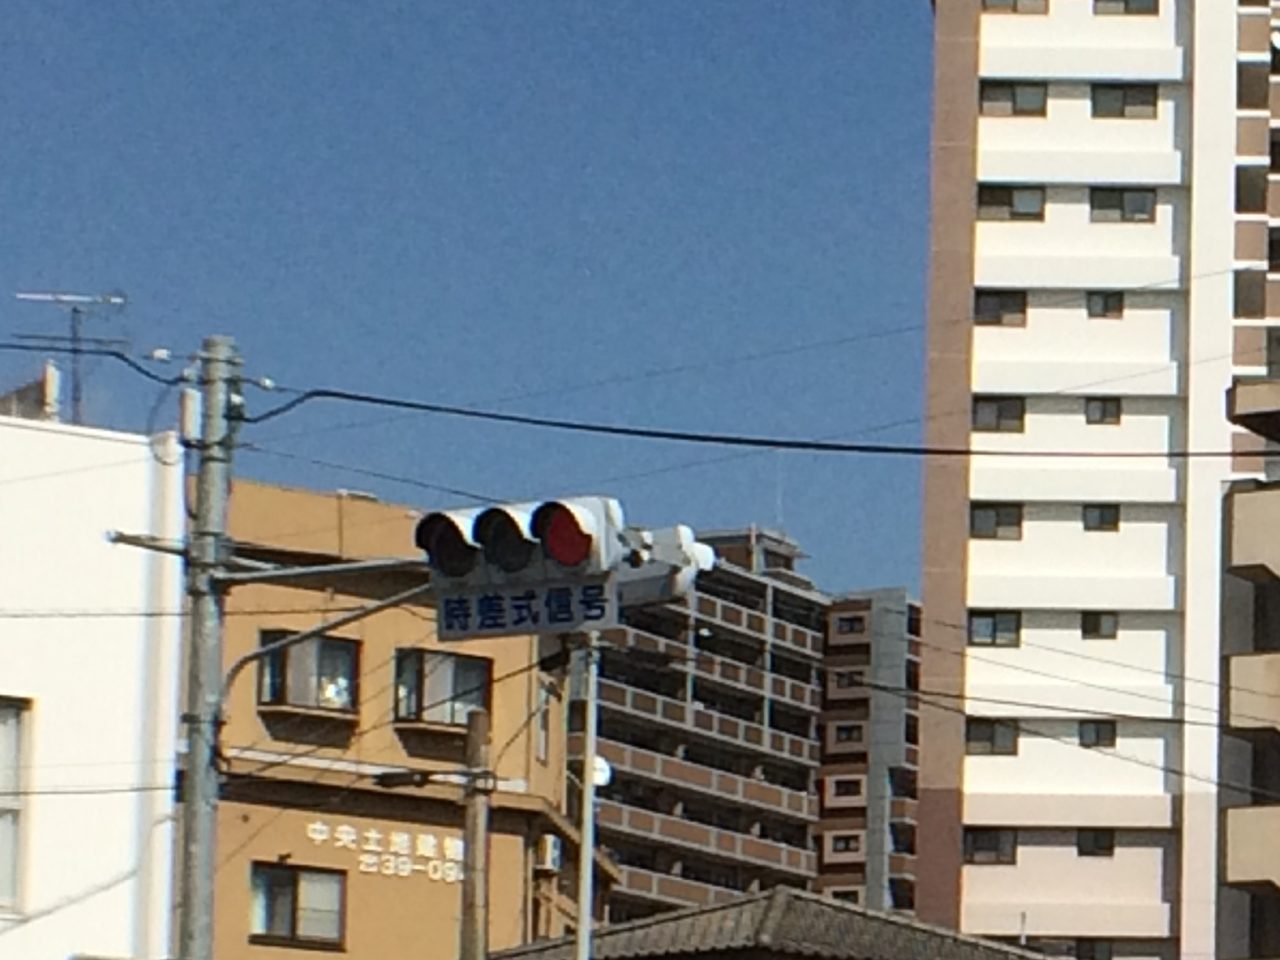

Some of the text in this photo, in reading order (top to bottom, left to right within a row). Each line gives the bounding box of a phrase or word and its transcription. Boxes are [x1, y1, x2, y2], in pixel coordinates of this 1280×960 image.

[444, 584, 608, 631] 時差式信号
